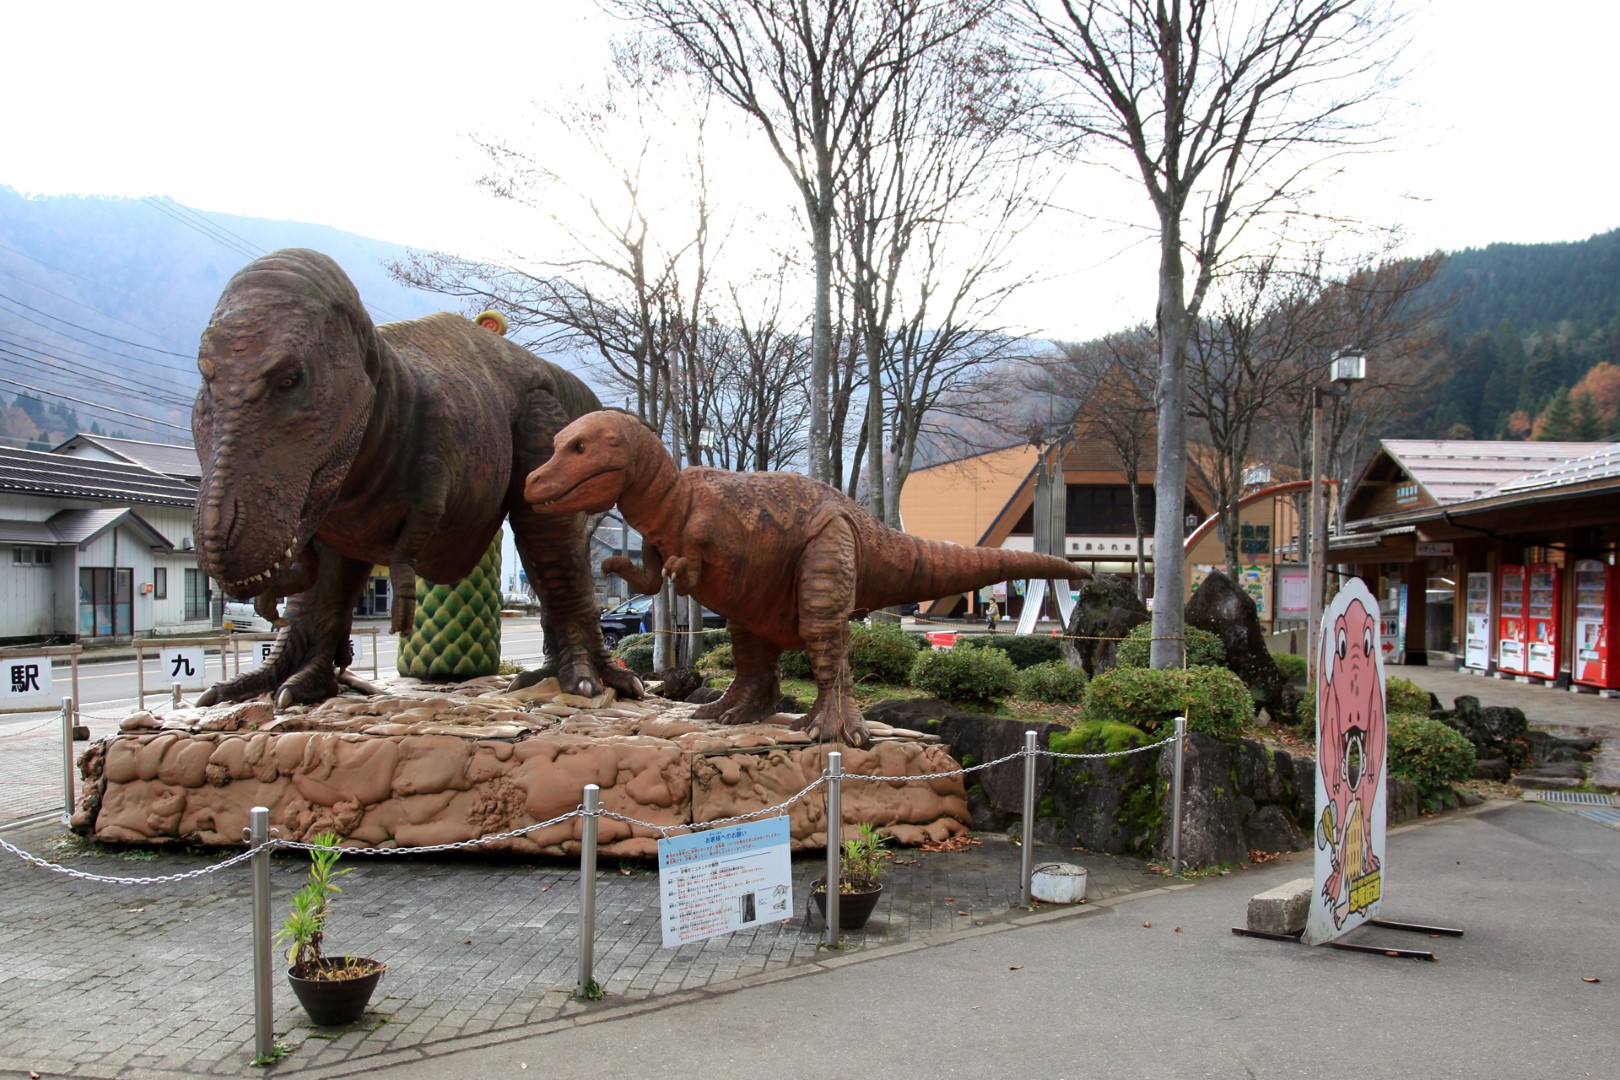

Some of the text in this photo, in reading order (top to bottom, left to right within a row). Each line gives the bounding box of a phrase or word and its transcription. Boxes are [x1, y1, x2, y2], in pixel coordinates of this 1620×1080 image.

[171, 654, 195, 677] 九
[11, 664, 40, 692] 駅
[705, 830, 747, 844] お客様へのお願い
